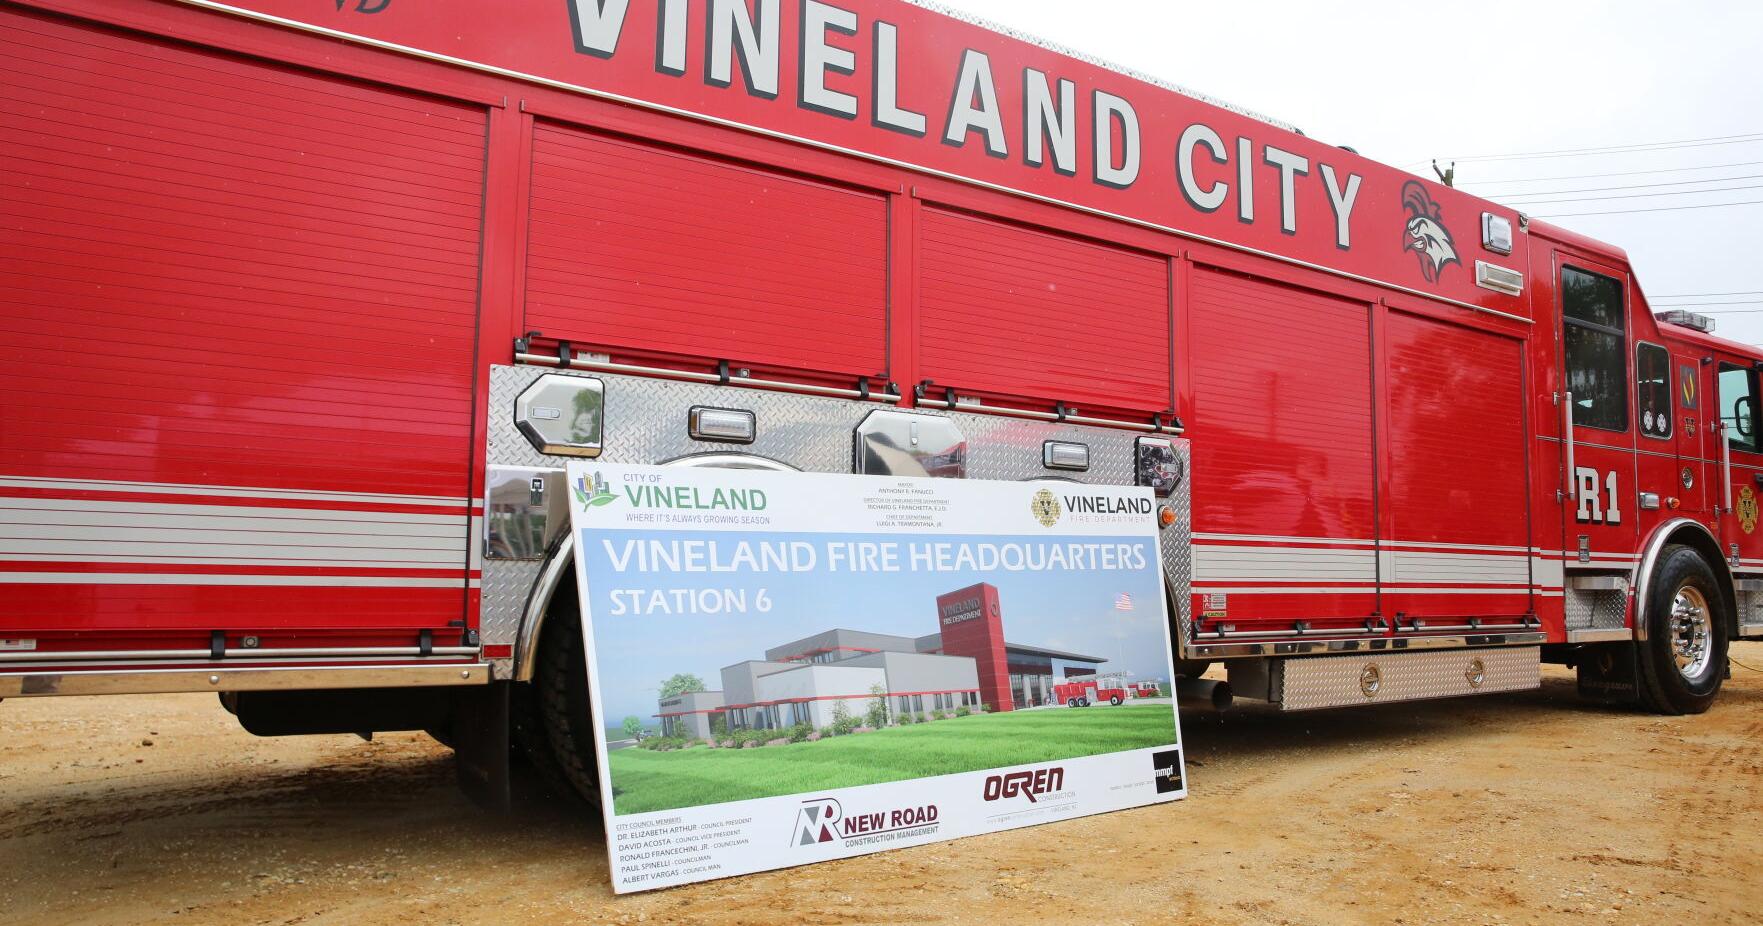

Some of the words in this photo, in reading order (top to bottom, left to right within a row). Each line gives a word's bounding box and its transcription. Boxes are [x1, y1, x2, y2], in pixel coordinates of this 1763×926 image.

[1175, 124, 1362, 250] CITY
[623, 473, 646, 482] CITY
[648, 474, 662, 483] OF
[624, 484, 767, 511] VINELAND
[1064, 495, 1152, 514] VINELAND
[1574, 466, 1621, 526] R1
[626, 513, 655, 523] WHERE
[656, 513, 671, 523] IT'S
[672, 514, 702, 524] ALWAYS
[703, 515, 739, 524] GROWING
[741, 516, 770, 525] SEASON
[1070, 515, 1090, 523] FIRE
[1095, 515, 1151, 523] DEPARTMENT
[602, 539, 817, 572] VINELAND
[826, 541, 898, 572] FIRE
[910, 542, 1146, 572] HEADQUARTERS
[609, 588, 746, 615] STATION
[755, 587, 773, 614] 6
[943, 598, 981, 616] VINELAND
[983, 767, 1064, 803] OGREN
[617, 833, 629, 841] DR.
[630, 829, 668, 839] ELIZABETH
[669, 825, 697, 834] ARTHUR
[700, 821, 724, 830] COUNCIL
[725, 817, 752, 827] PRESIDENT
[629, 820, 654, 829] COUNCIL
[844, 812, 886, 835] NEW
[891, 804, 938, 827] ROAD
[618, 842, 642, 852] DAVID
[643, 838, 671, 848] ACOSTA
[675, 834, 699, 844] COUNCIL
[701, 832, 712, 840] VICE
[713, 829, 741, 839] PRESIDENT
[845, 834, 895, 848] CONSTRUCTION
[896, 825, 940, 840] MANAGEMENT
[620, 852, 650, 862] RONALD
[700, 843, 710, 851] JR.
[713, 838, 749, 849] COUNCILMAN
[621, 865, 640, 873] PAUL
[641, 858, 670, 870] SPINELLI
[674, 854, 711, 865] COUNCILMAN
[622, 874, 649, 884] ALBERT
[651, 869, 679, 880] VARGAS
[682, 866, 706, 875] COUNCIL
[707, 863, 721, 871] MAN
